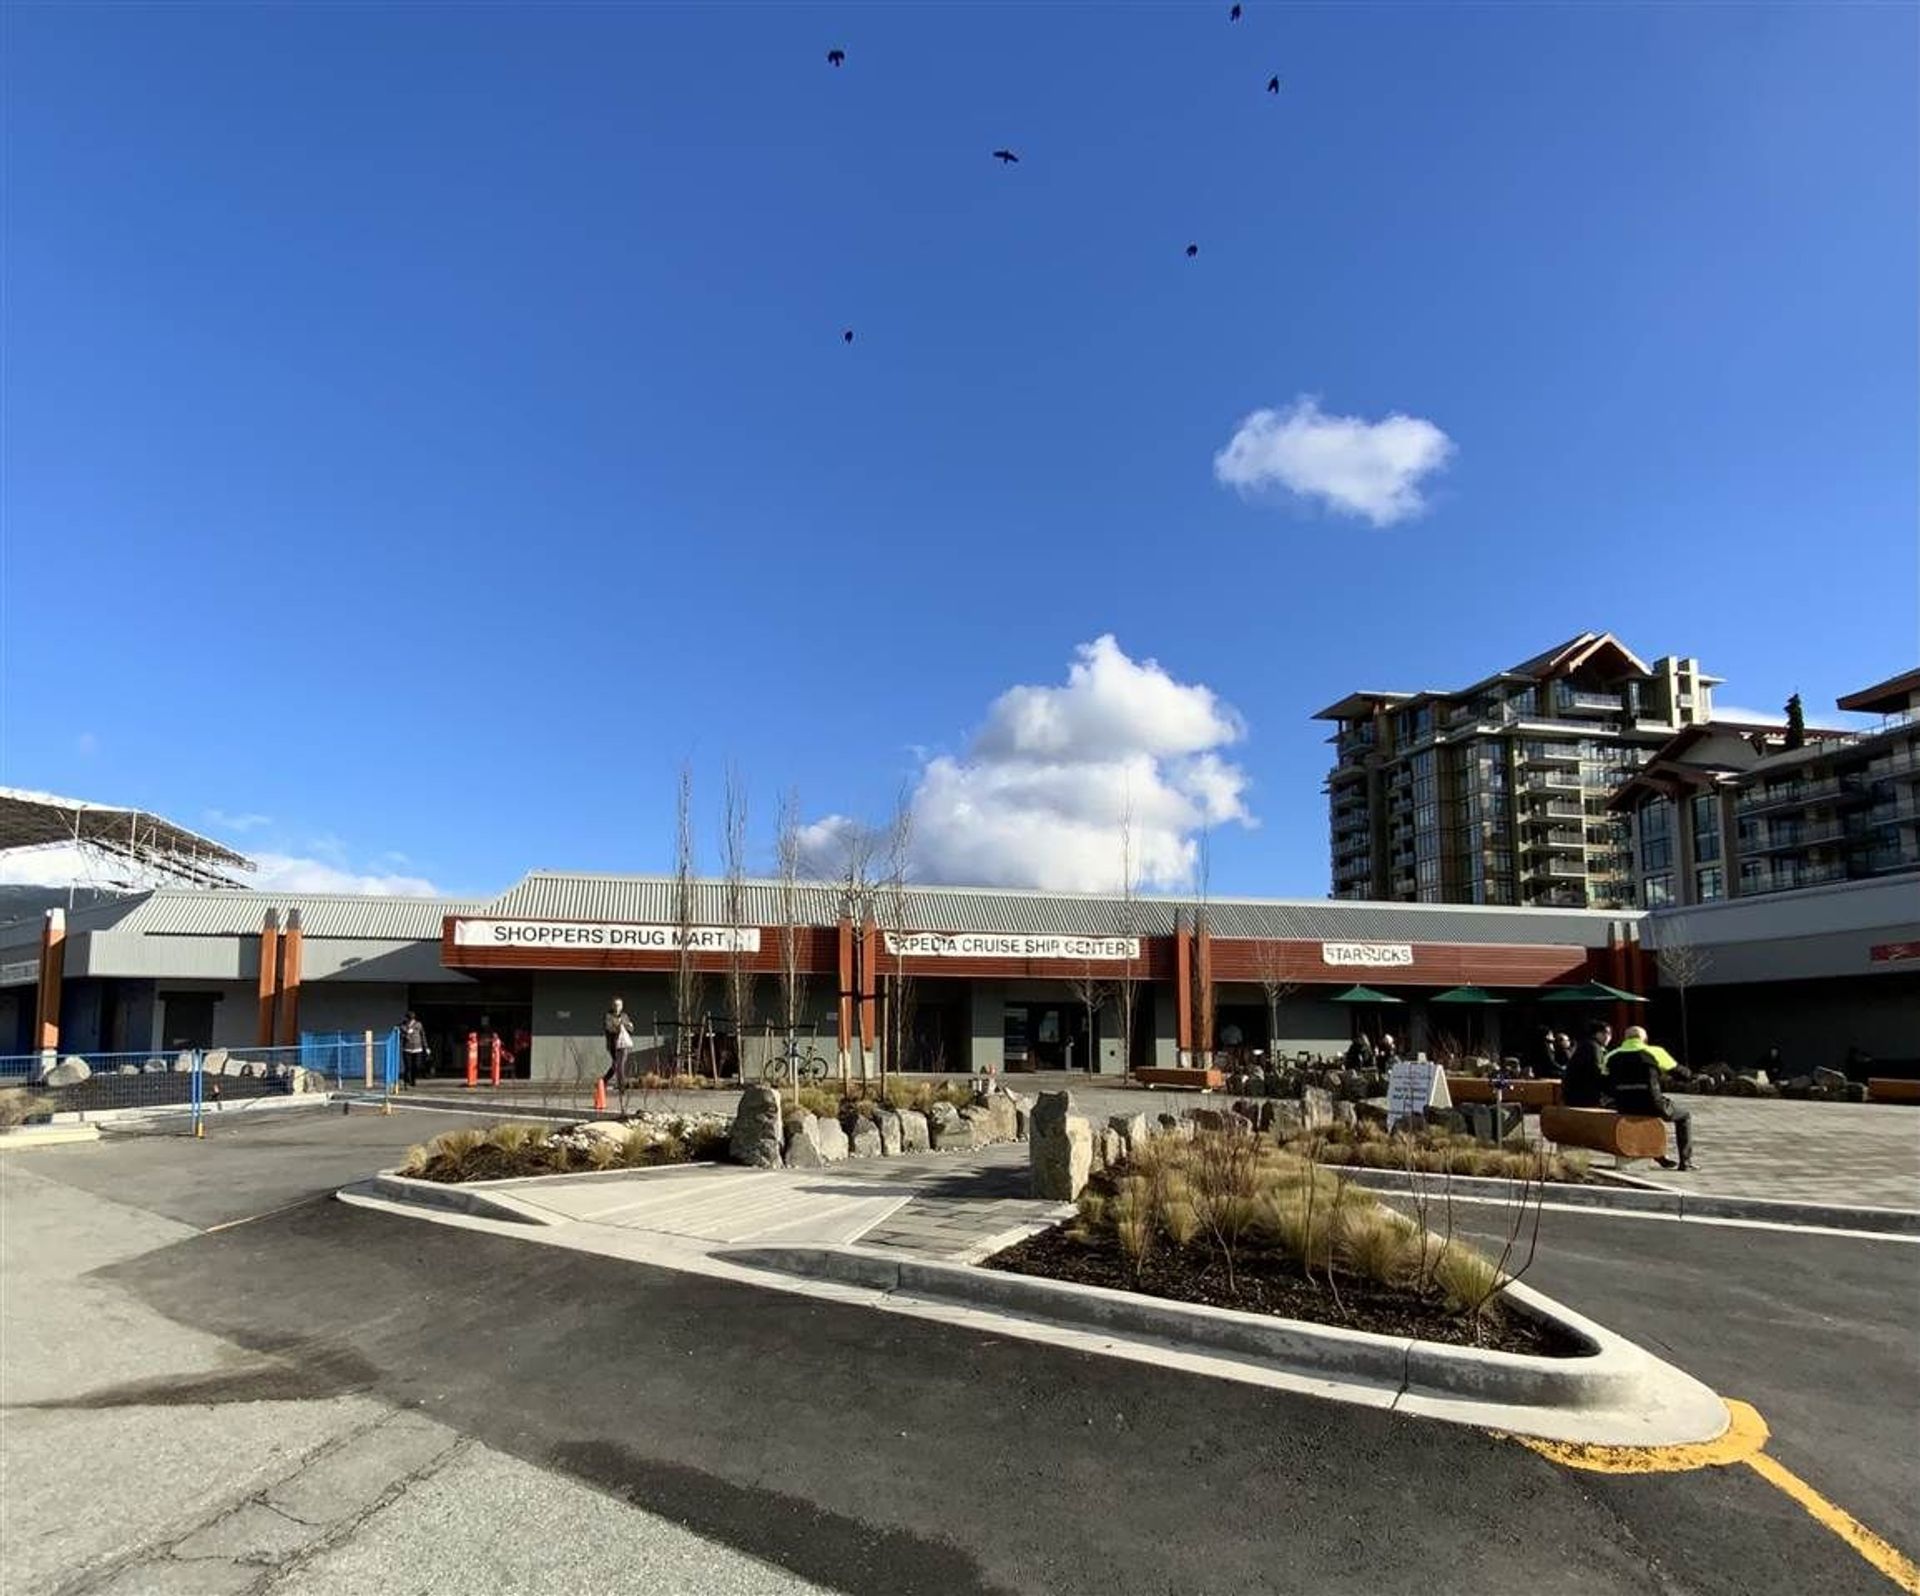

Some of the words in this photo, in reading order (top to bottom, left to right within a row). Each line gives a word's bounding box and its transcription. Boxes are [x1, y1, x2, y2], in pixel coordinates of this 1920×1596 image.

[494, 926, 603, 944] SHOPPERS
[610, 928, 665, 946] DRUG
[672, 931, 726, 947] MART
[962, 938, 1020, 954] CRUISE
[1025, 939, 1060, 953] SHIP
